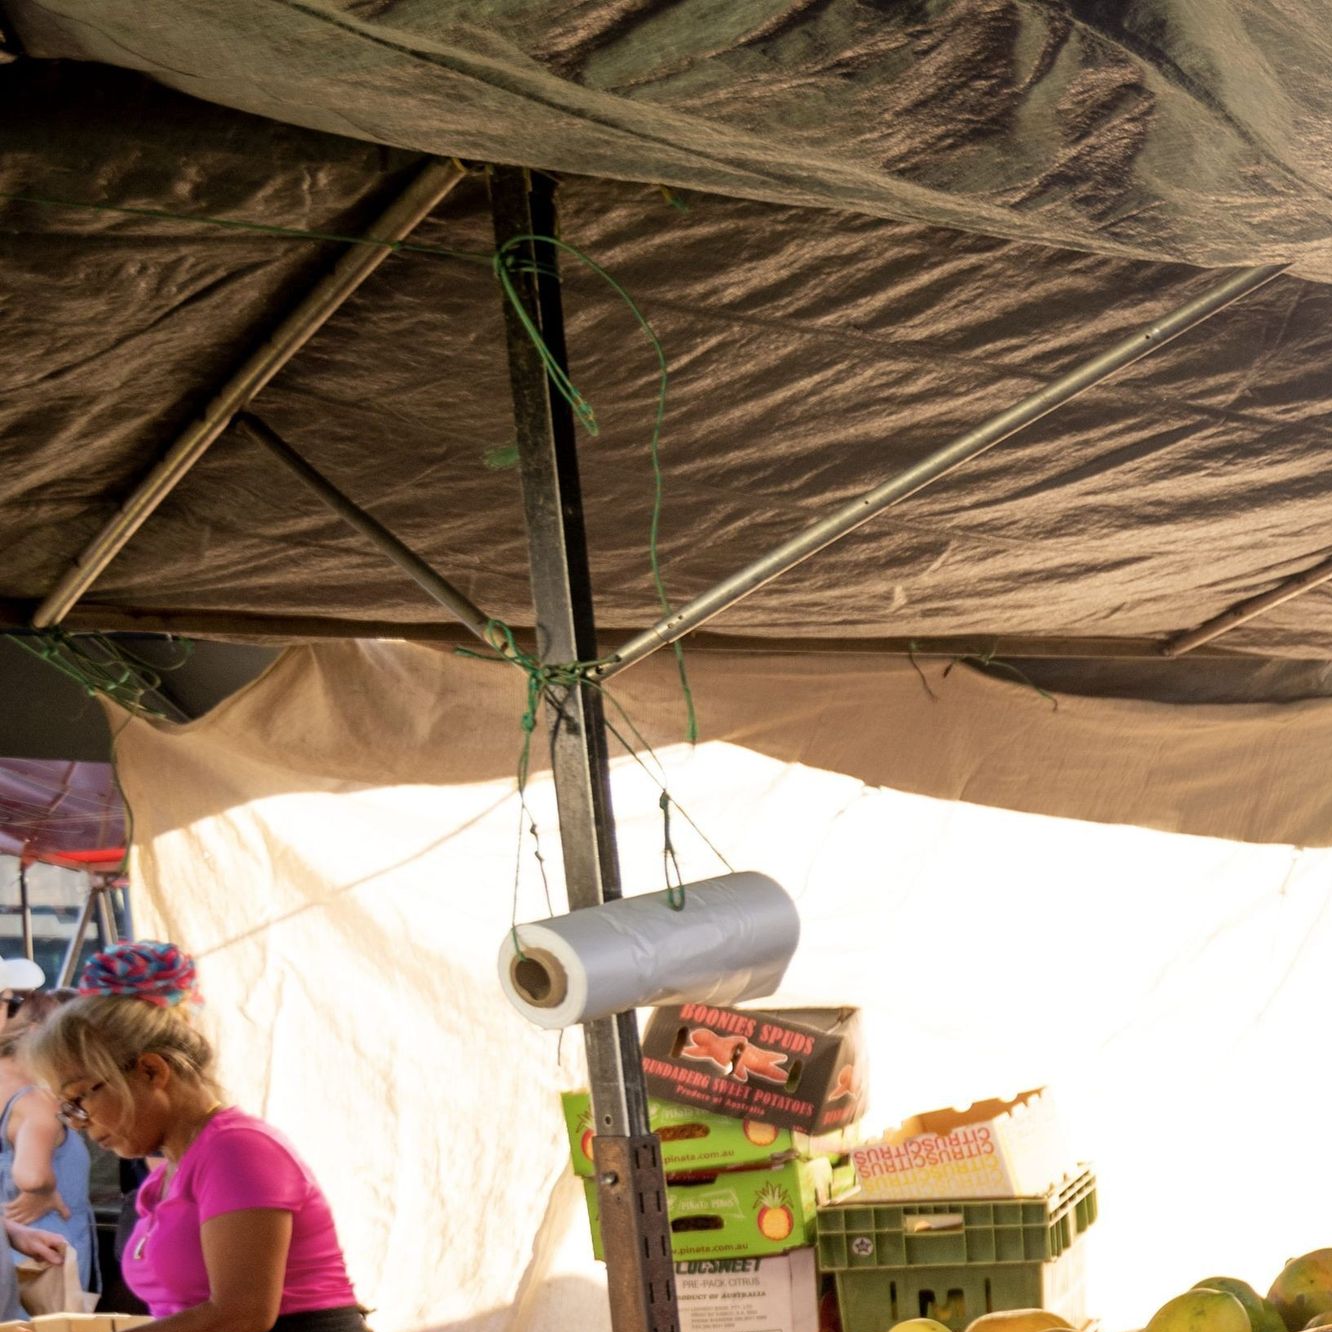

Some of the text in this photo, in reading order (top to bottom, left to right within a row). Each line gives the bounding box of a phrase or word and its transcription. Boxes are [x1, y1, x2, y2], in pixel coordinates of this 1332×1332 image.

[679, 1003, 816, 1056] BOONIES SPUDS
[712, 1078, 750, 1101] SWEET
[754, 1089, 815, 1117] POTATOES
[682, 1276, 760, 1289] PRE-PACK CITRUS
